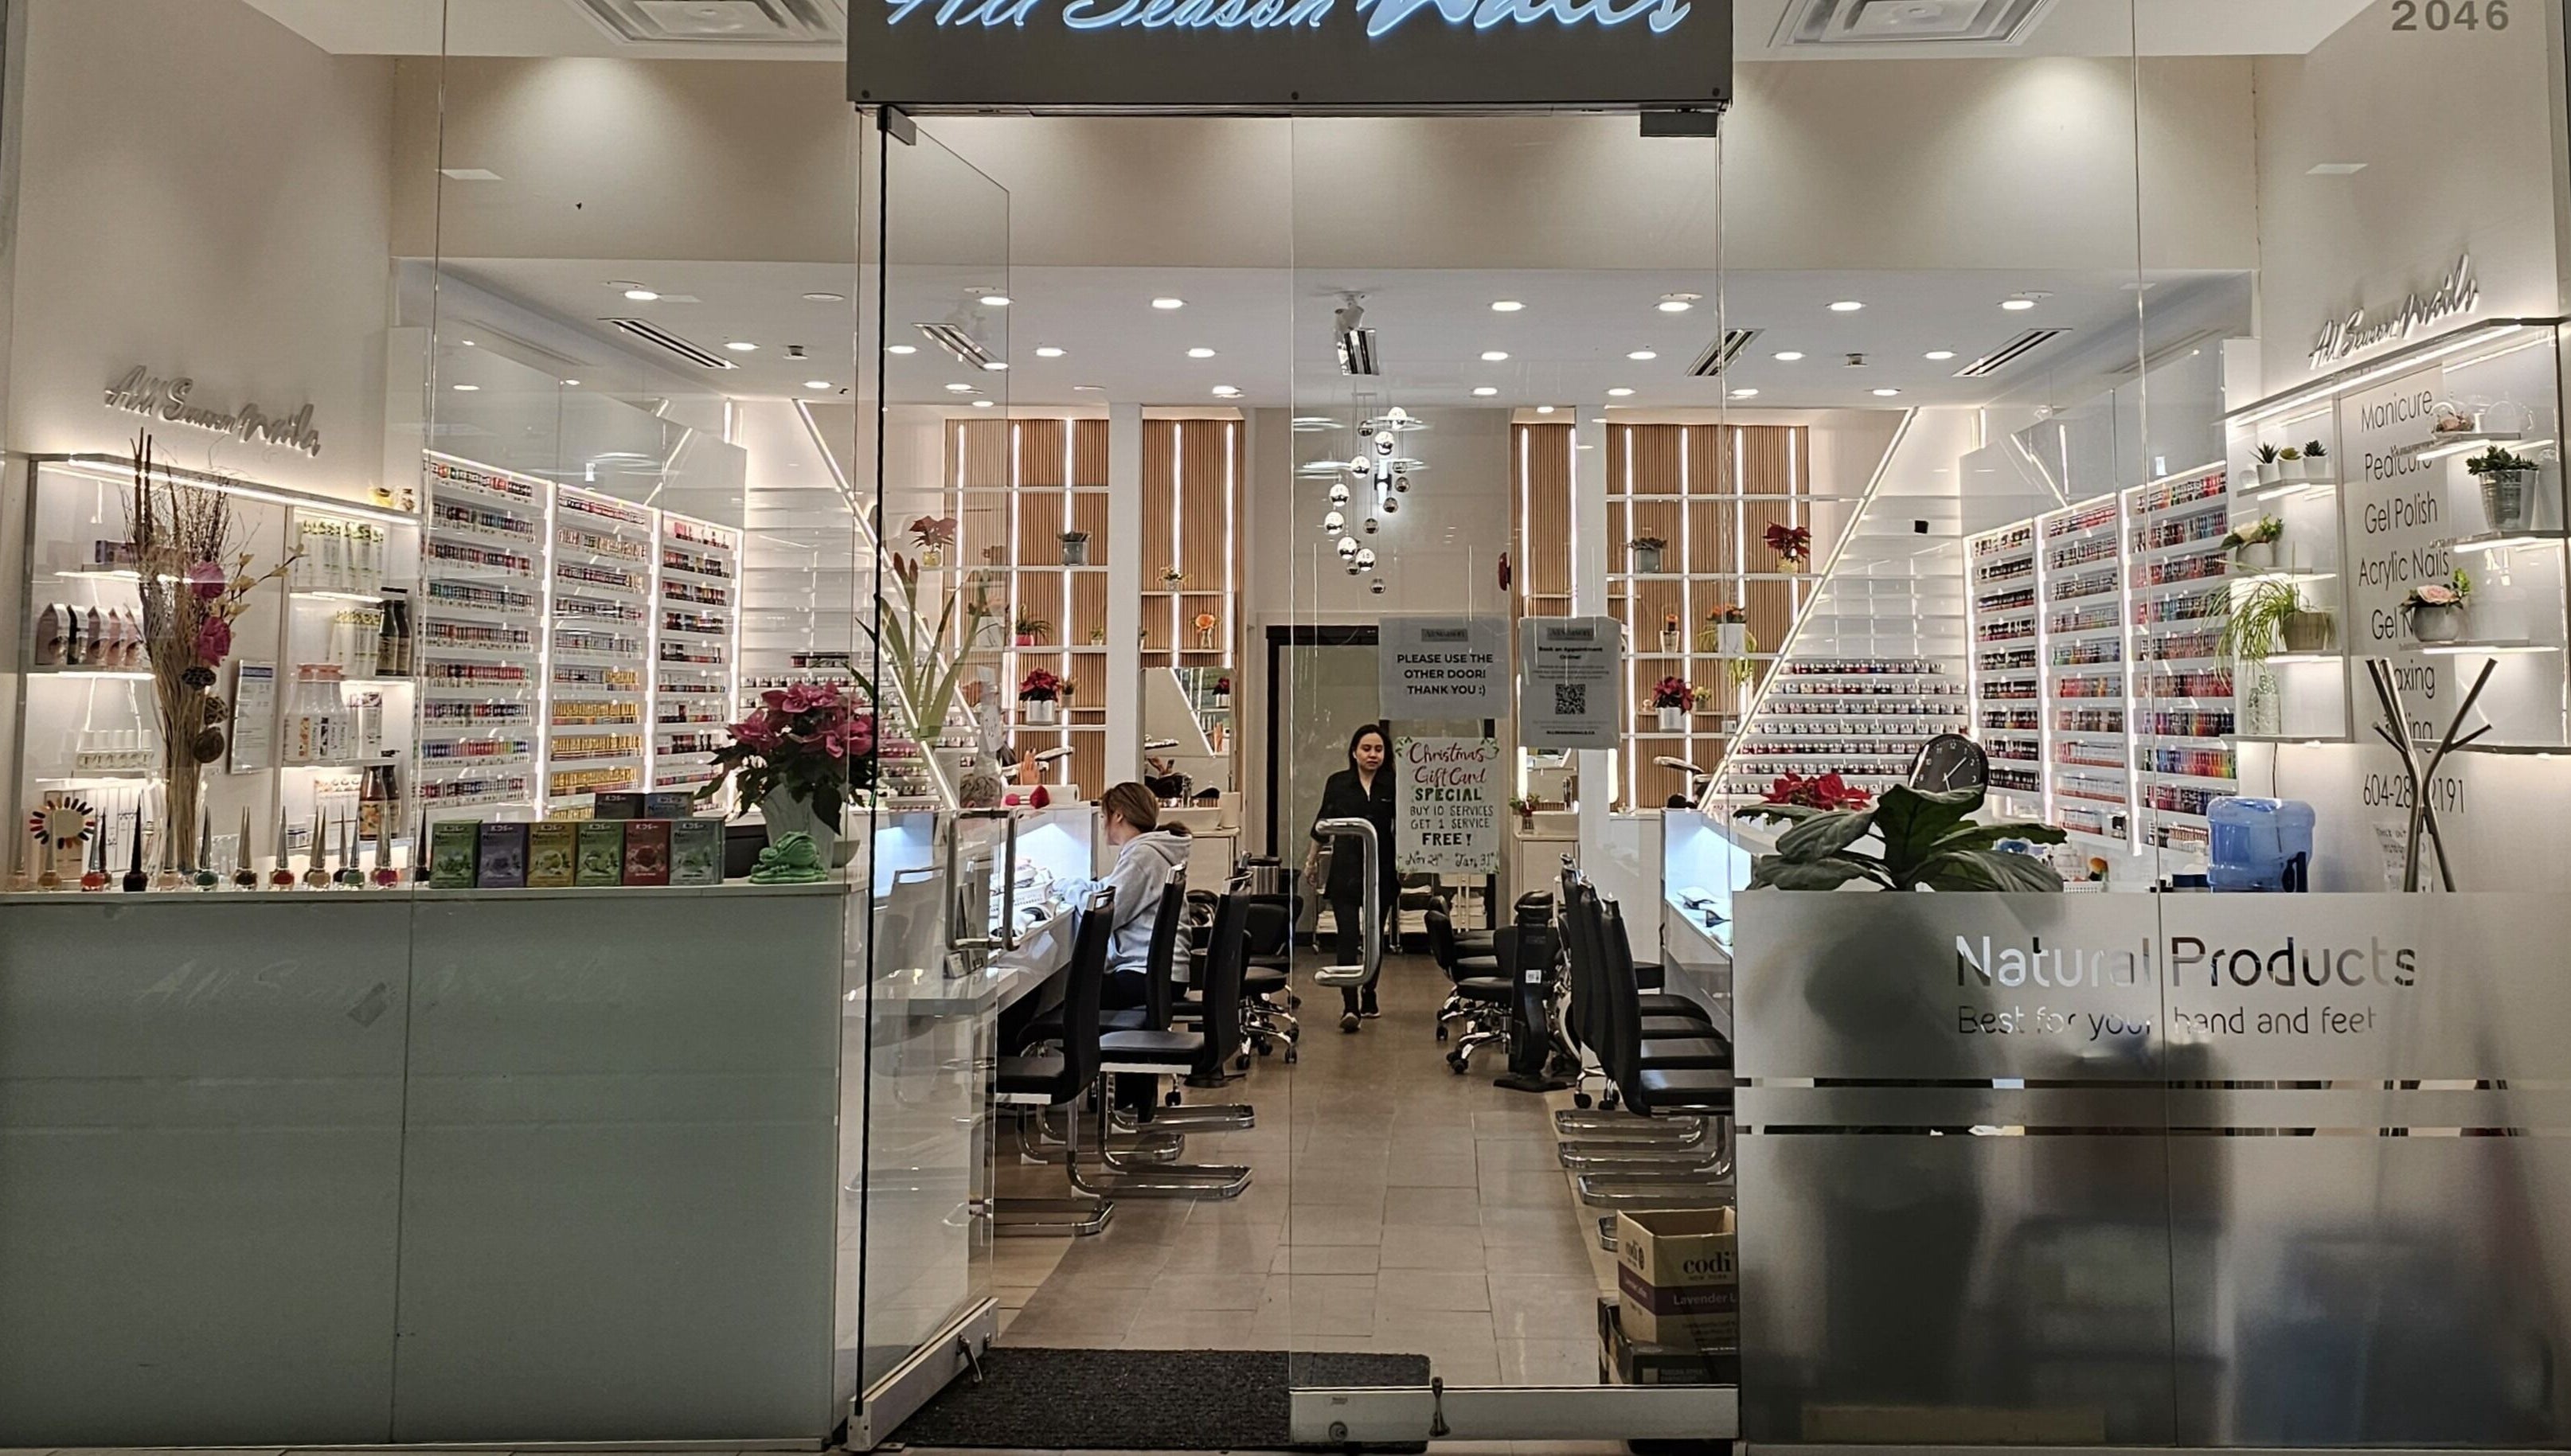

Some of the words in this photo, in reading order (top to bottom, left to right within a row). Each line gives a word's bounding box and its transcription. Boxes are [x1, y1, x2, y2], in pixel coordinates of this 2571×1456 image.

[2392, 0, 2508, 30] 2046
[2308, 319, 2346, 369] All
[104, 365, 165, 416] All
[2361, 389, 2432, 433] Manicure
[2365, 499, 2390, 534] Gel
[2395, 490, 2437, 529] Polish
[2358, 550, 2408, 591] Acrylic
[2413, 548, 2449, 580] Nails
[2372, 607, 2397, 640] Gel
[1397, 654, 1442, 663] PLEASE
[1444, 654, 1467, 663] USE
[1470, 654, 1494, 663] THE
[1404, 669, 1444, 678] OTHER
[1448, 669, 1486, 678] DOOR!
[2389, 658, 2435, 699] axing
[1406, 685, 1448, 695] THANK
[1451, 685, 1476, 695] YOU
[1479, 685, 1486, 697] :)
[1409, 742, 1486, 763] Christmas
[1414, 765, 1448, 787] Gift
[1449, 767, 1487, 786] Card
[1415, 787, 1482, 802] SPECIAL
[1410, 806, 1430, 816] BUY
[1433, 806, 1444, 816] 10
[1450, 805, 1494, 816] SERVICES
[1411, 819, 1430, 829] GET
[1439, 818, 1444, 829] 1
[1452, 818, 1490, 829] SERVICE
[1956, 936, 2151, 987] Natural
[2171, 936, 2416, 987] Products
[1958, 1005, 2025, 1035] Best
[2036, 1006, 2076, 1034] for
[2089, 1013, 2152, 1041] your
[2174, 1006, 2245, 1035] hand
[2257, 1006, 2309, 1034] and
[2322, 1006, 2377, 1034] feet
[1683, 1251, 1732, 1274] codi
[1674, 1294, 1727, 1306] Lavender
